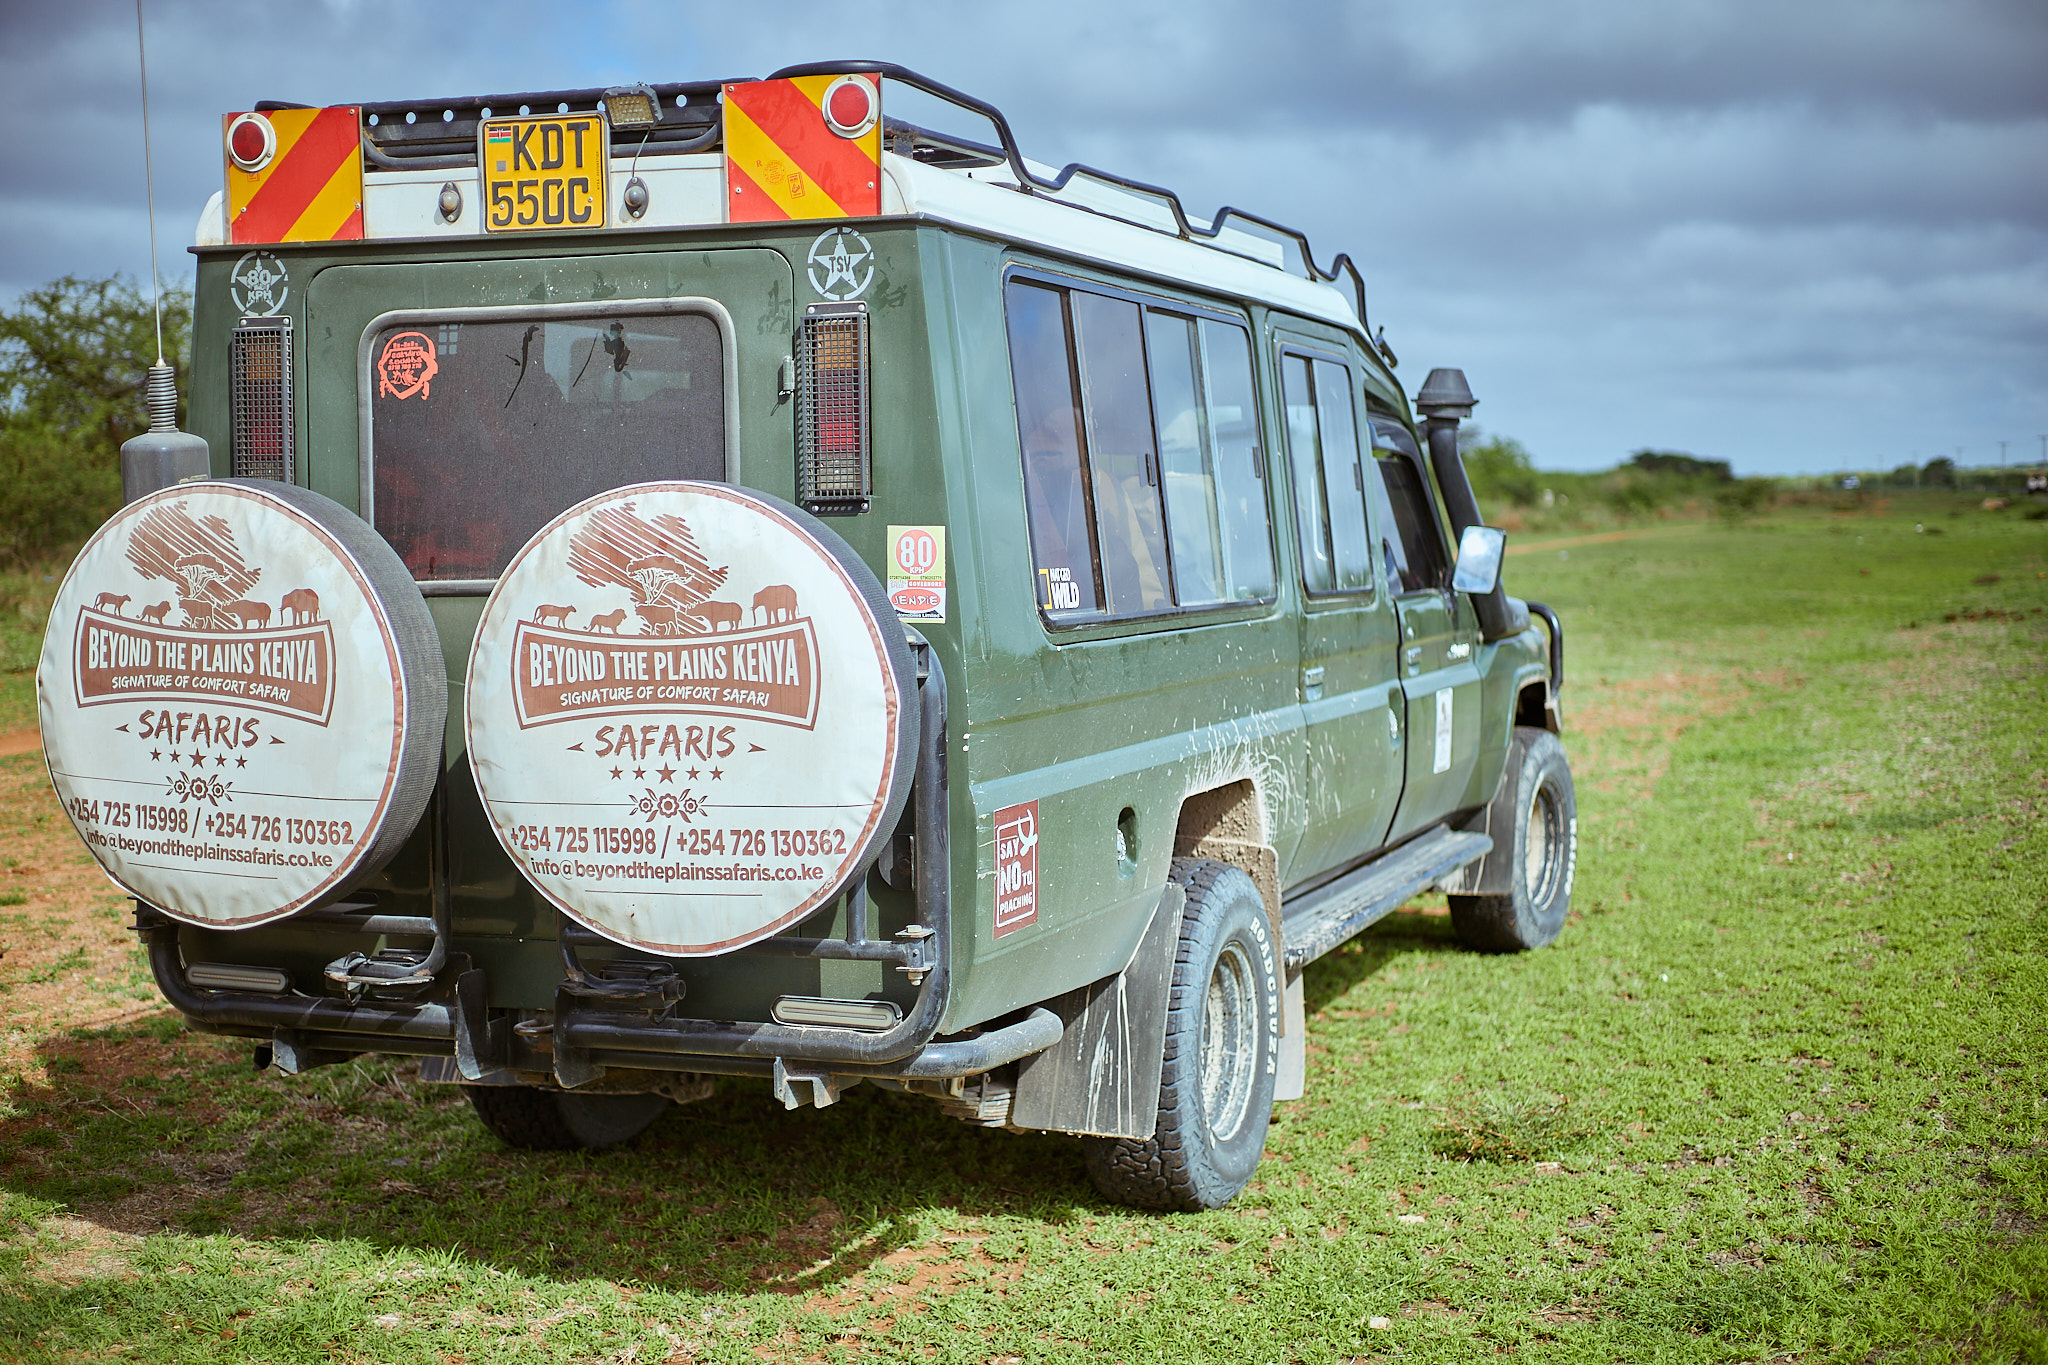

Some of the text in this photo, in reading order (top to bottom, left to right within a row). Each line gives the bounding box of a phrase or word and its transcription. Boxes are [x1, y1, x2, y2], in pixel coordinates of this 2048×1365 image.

[513, 122, 590, 171] KDT
[492, 177, 592, 226] 550C
[247, 269, 271, 285] 80
[829, 256, 851, 273] TSV
[248, 290, 272, 302] KPH
[900, 536, 932, 568] 80
[909, 566, 924, 574] KPH
[894, 595, 938, 606] JENDIE
[1051, 582, 1080, 609] WILD
[88, 626, 317, 685] BEYOND THE PLAINS KENYA
[530, 638, 800, 688] BEYOND THE PLAINS KENYA
[111, 674, 290, 703] SIGNATURE OF COMFORT SAFARI
[560, 686, 770, 707] SIGNATURE OF COMFORT SAFARI
[138, 709, 260, 750] SAFARIS
[595, 724, 736, 761] SAFARIS
[69, 798, 354, 846] +254 725 115998 / +254 726 130362
[85, 828, 333, 868] info@beyondtheplainssafaris.co.ke
[511, 825, 847, 858] +254 725 115998 / +254 726 130362
[1000, 837, 1019, 860] SAY
[531, 858, 823, 883] info@beyondtheplainssafaris.co.ke
[1000, 861, 1032, 896] NO TO
[1000, 892, 1032, 916] POACHING
[1249, 916, 1278, 1075] ROADCRUZA
